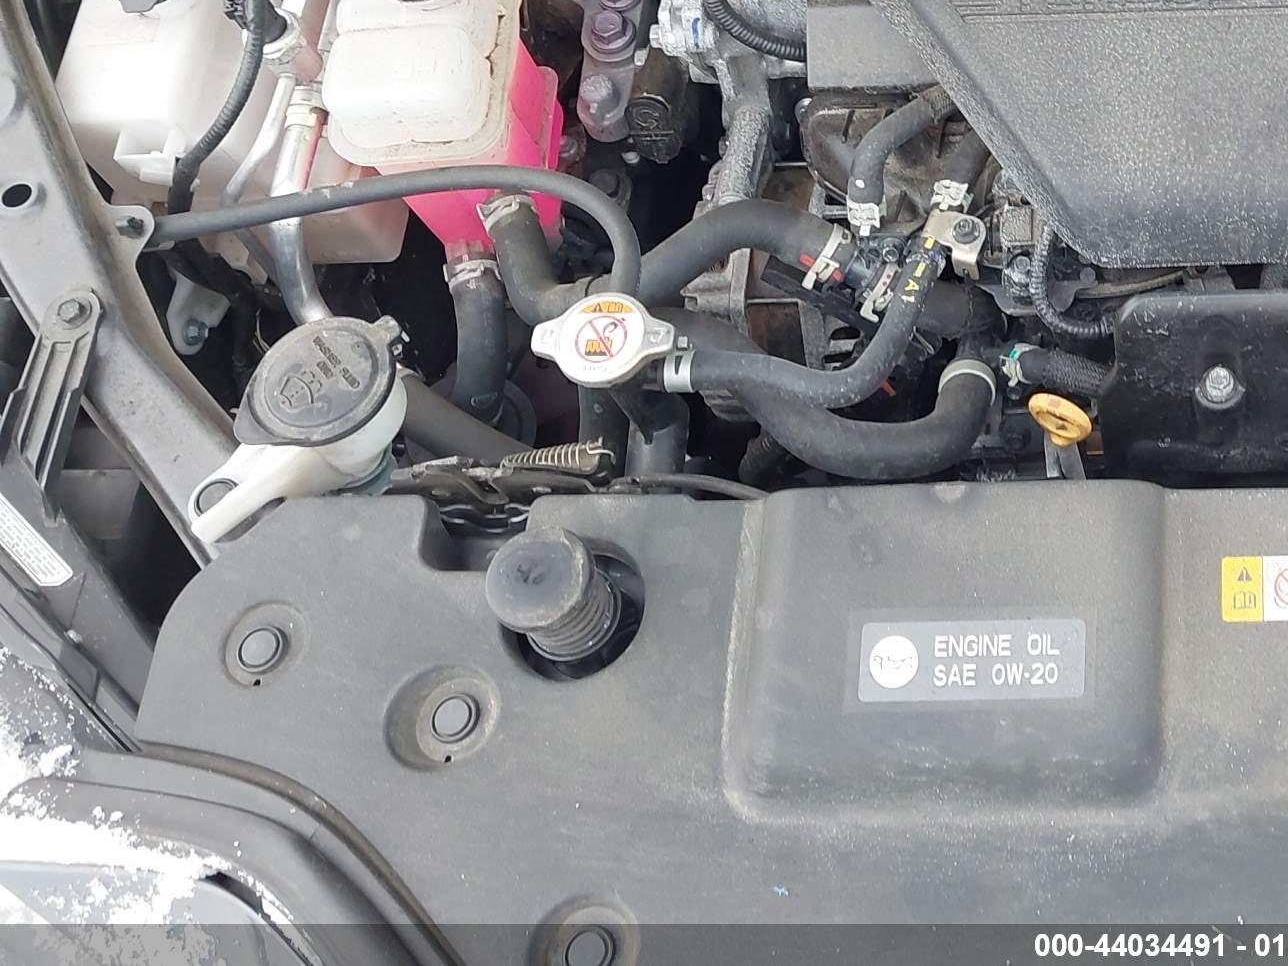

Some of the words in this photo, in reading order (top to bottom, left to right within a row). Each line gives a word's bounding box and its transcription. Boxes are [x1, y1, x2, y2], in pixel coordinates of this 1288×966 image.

[934, 634, 1012, 658] ENGINE
[1026, 633, 1060, 656] OIL
[933, 663, 977, 687] SAE
[991, 662, 1059, 685] 0W-20
